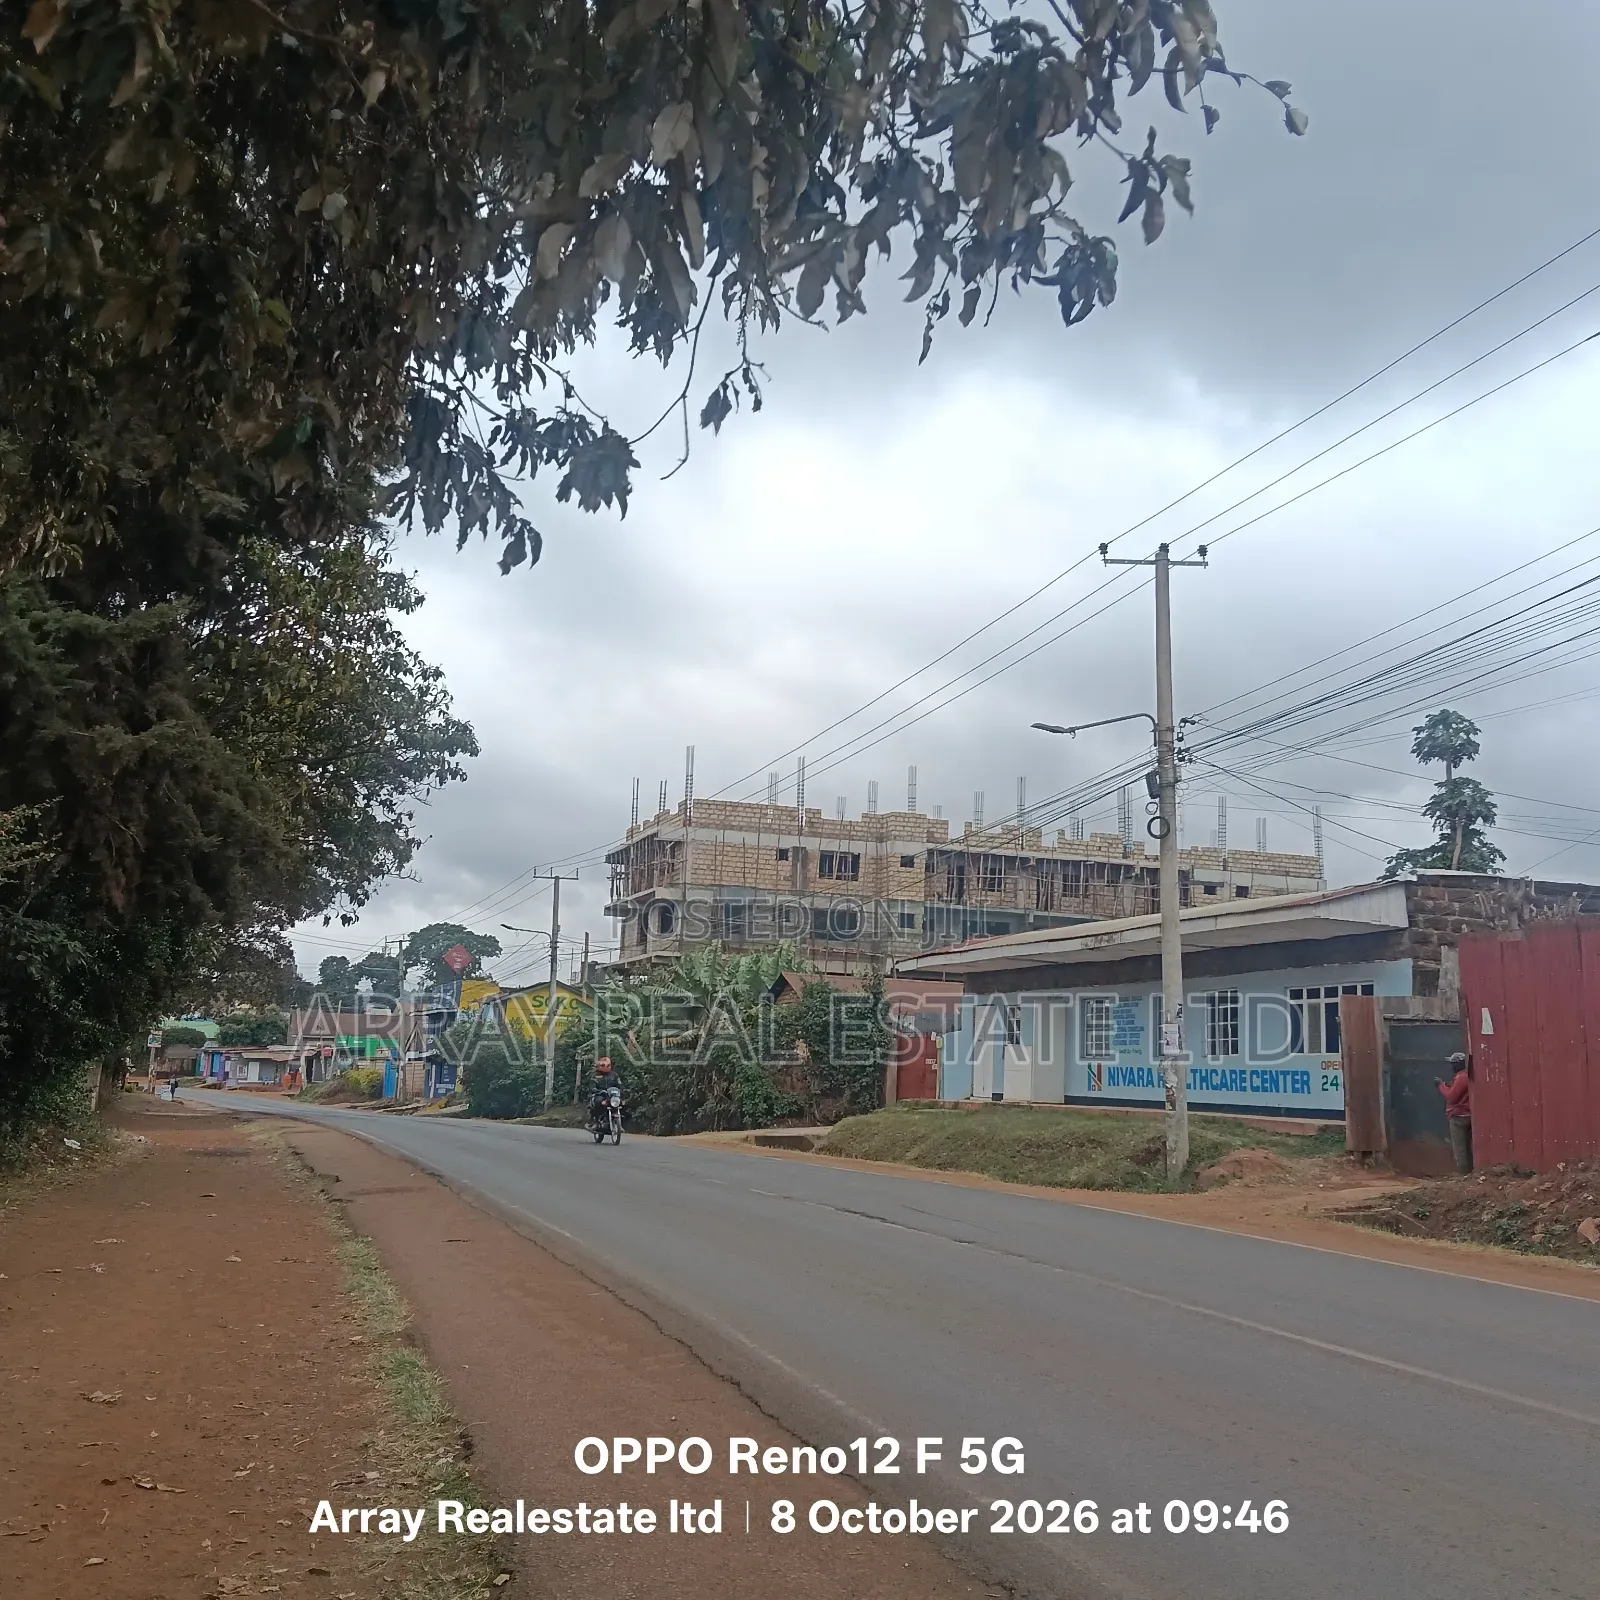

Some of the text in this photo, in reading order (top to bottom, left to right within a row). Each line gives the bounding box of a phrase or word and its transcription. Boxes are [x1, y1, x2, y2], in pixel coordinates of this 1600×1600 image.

[1107, 1066, 1311, 1094] NIVARA HTHCARE CENTER
[1321, 1074, 1340, 1092] 24
